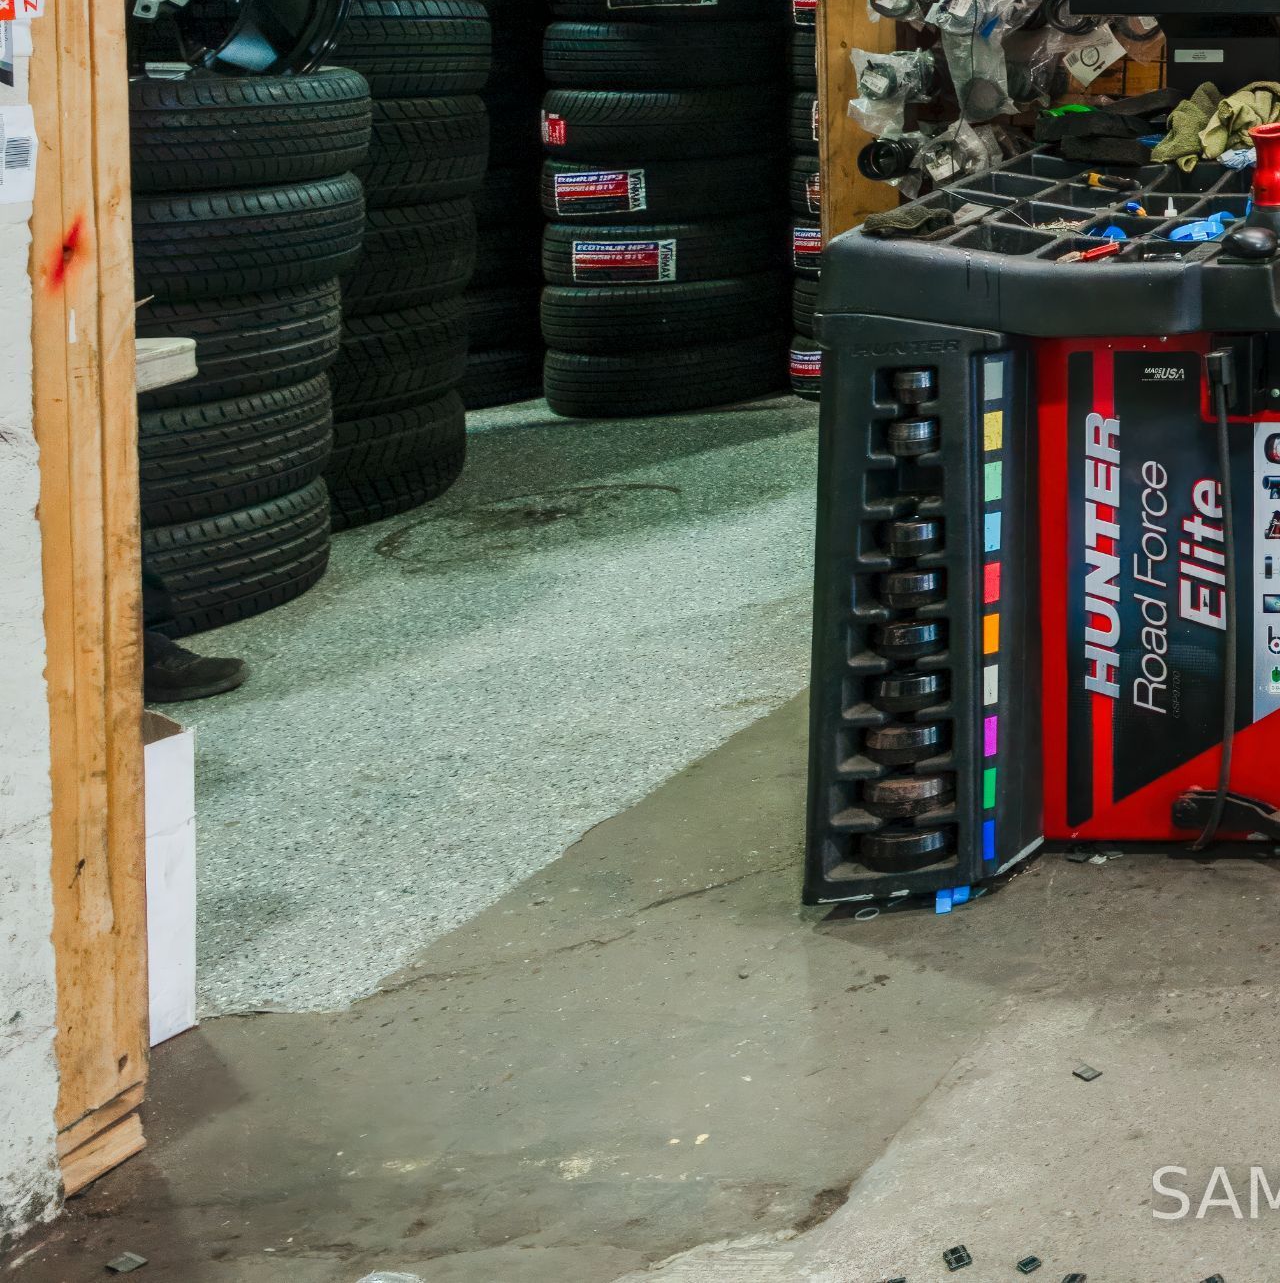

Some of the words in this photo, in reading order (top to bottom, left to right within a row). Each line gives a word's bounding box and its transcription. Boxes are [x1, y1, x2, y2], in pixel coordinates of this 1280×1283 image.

[1160, 367, 1185, 379] USA
[1085, 412, 1121, 700] HUNTER
[1134, 460, 1168, 588] Force
[1180, 479, 1227, 631] Elite
[1134, 593, 1168, 714] Road
